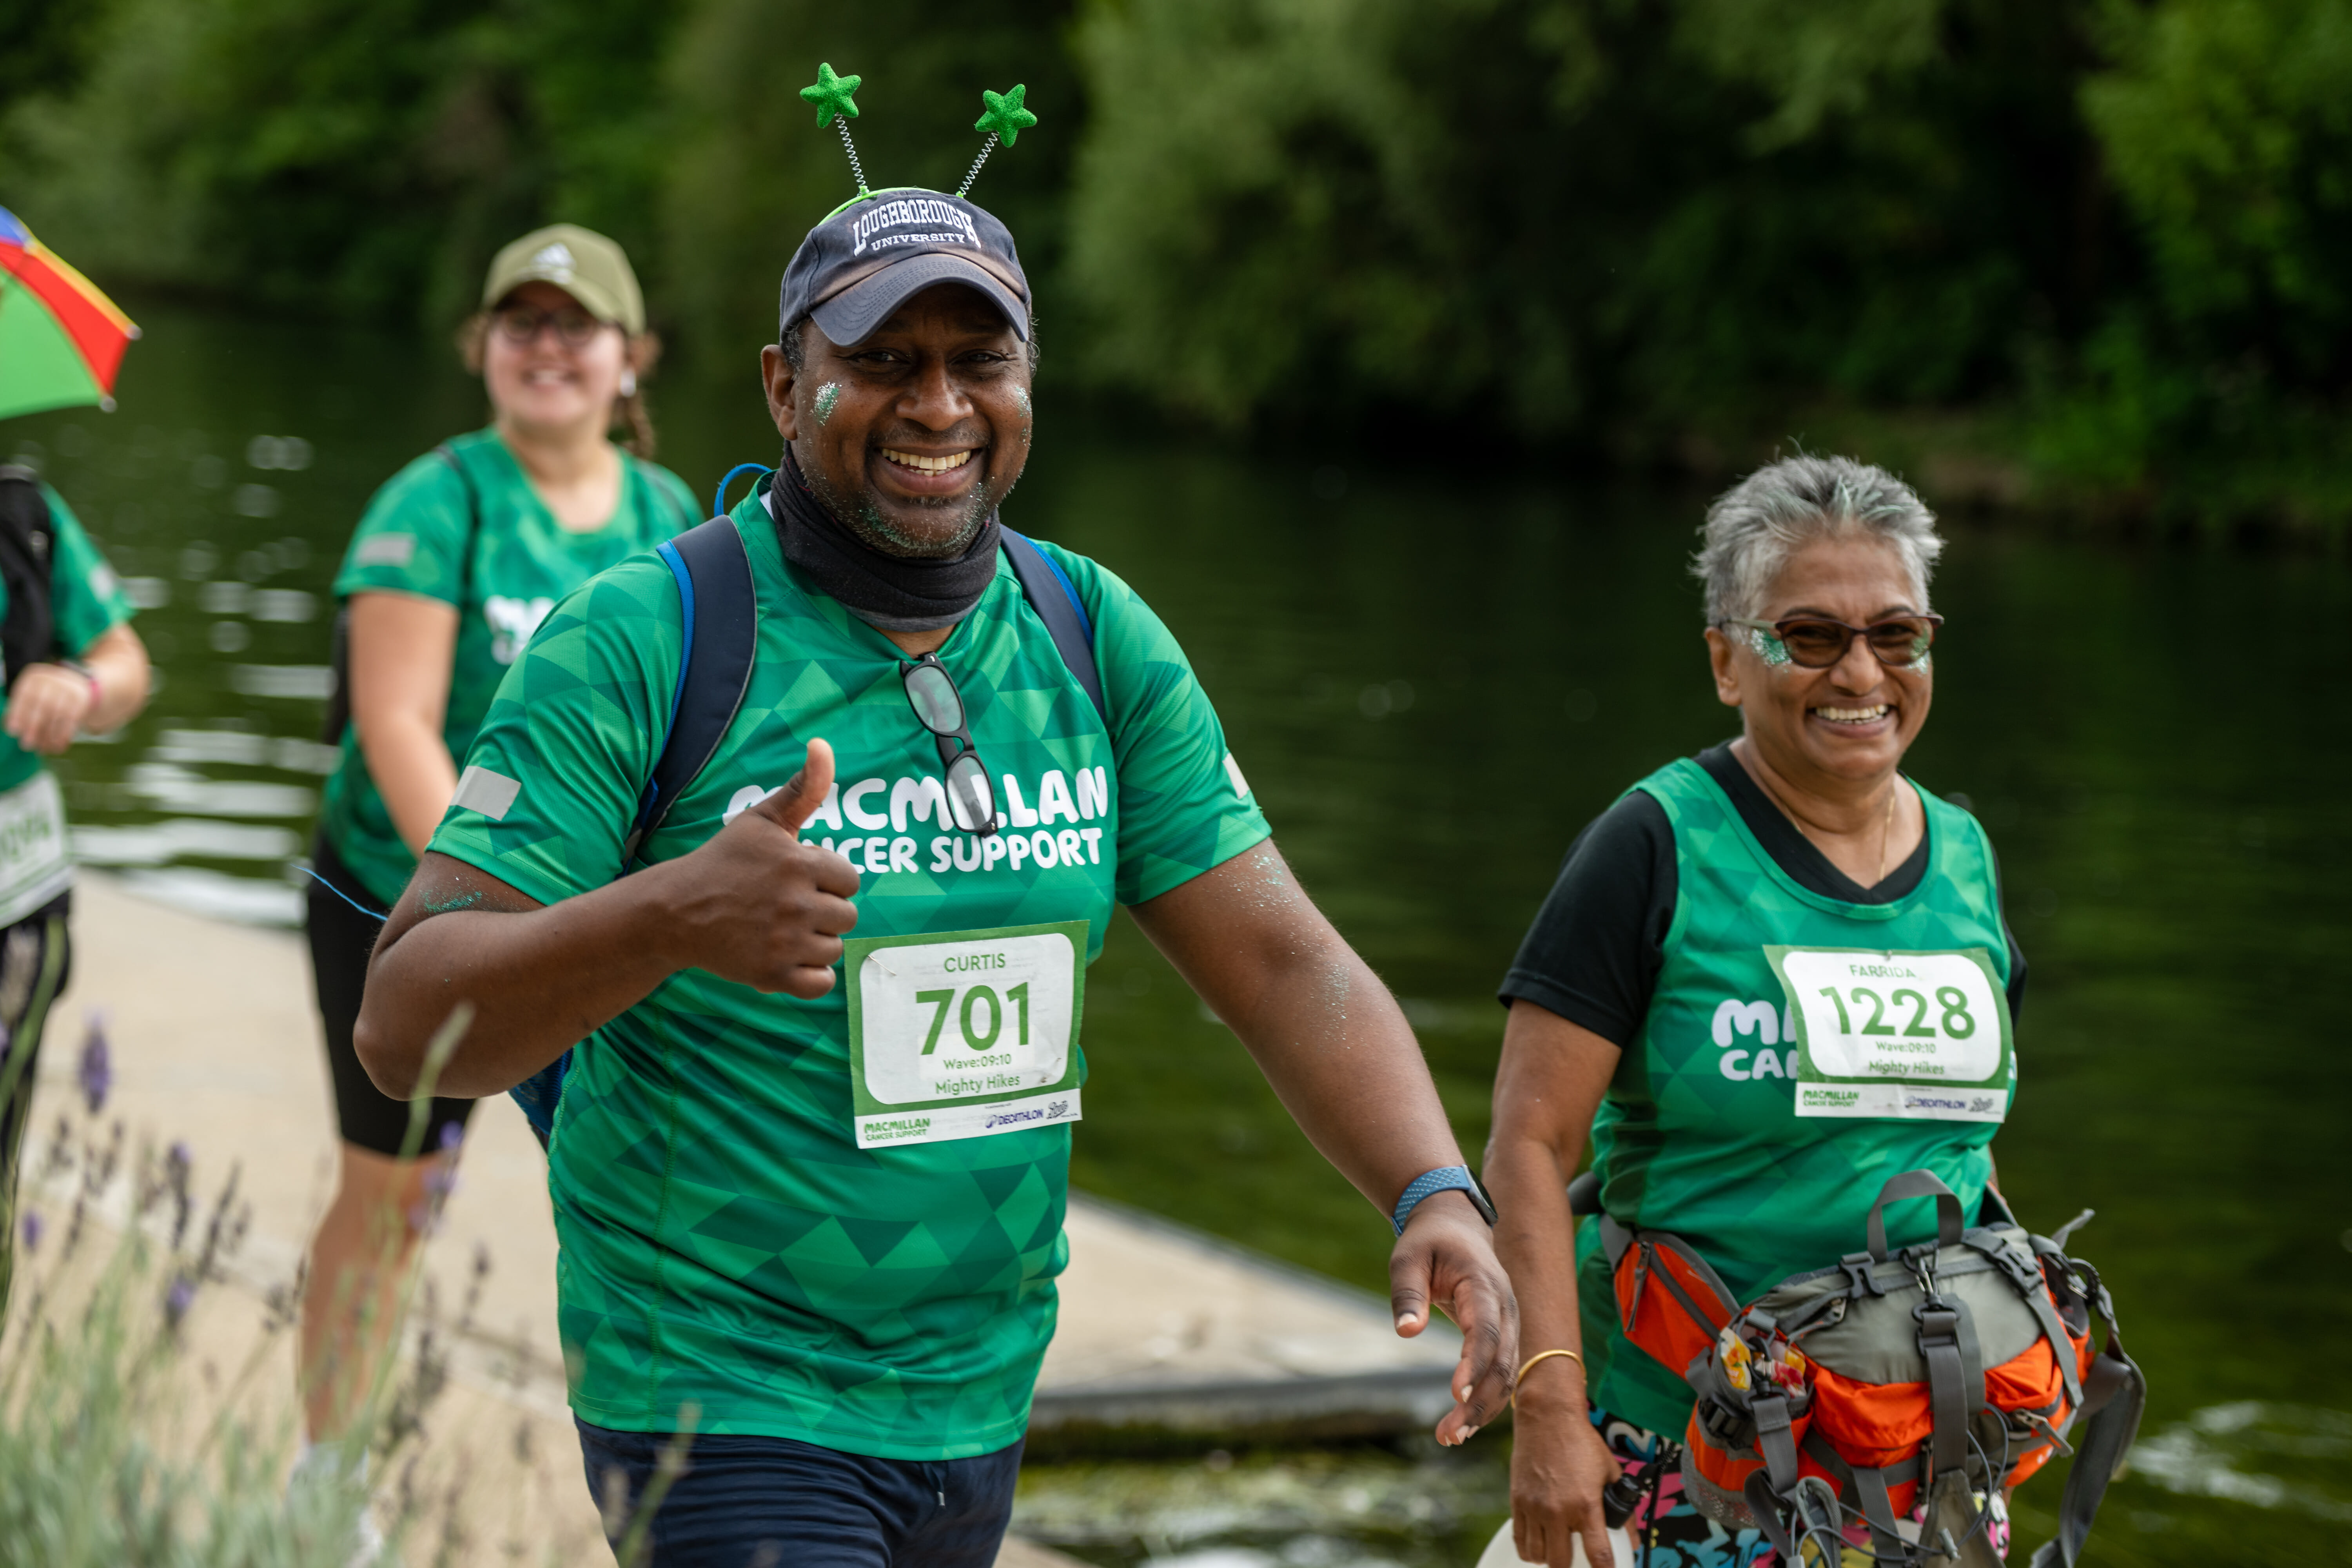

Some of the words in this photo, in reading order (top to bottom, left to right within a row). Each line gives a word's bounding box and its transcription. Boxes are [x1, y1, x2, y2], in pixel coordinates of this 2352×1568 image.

[853, 199, 981, 256] LOUGHBOROUGH
[871, 233, 964, 251] UNIVERSITY
[930, 828, 1102, 873] SUPPORT
[944, 953, 1006, 972] CURTIS
[1849, 964, 1917, 979] FARRIDA
[916, 982, 1029, 1056] 701
[1819, 986, 1976, 1040] 1228
[1876, 1041, 1936, 1054] Wave:09:10
[943, 1054, 1011, 1070] Wave:09:10
[1869, 1059, 1910, 1076] Mighty
[1913, 1060, 1945, 1074] Hikes
[935, 1078, 983, 1095] Mighty
[987, 1074, 1020, 1089] Hikes
[1803, 1090, 1860, 1100] MACMILLAN
[864, 1118, 931, 1133] MACMILLAN
[998, 1109, 1044, 1125] DECATHLON
[866, 1132, 894, 1141] CANCER
[895, 1129, 927, 1138] SUPPORT
